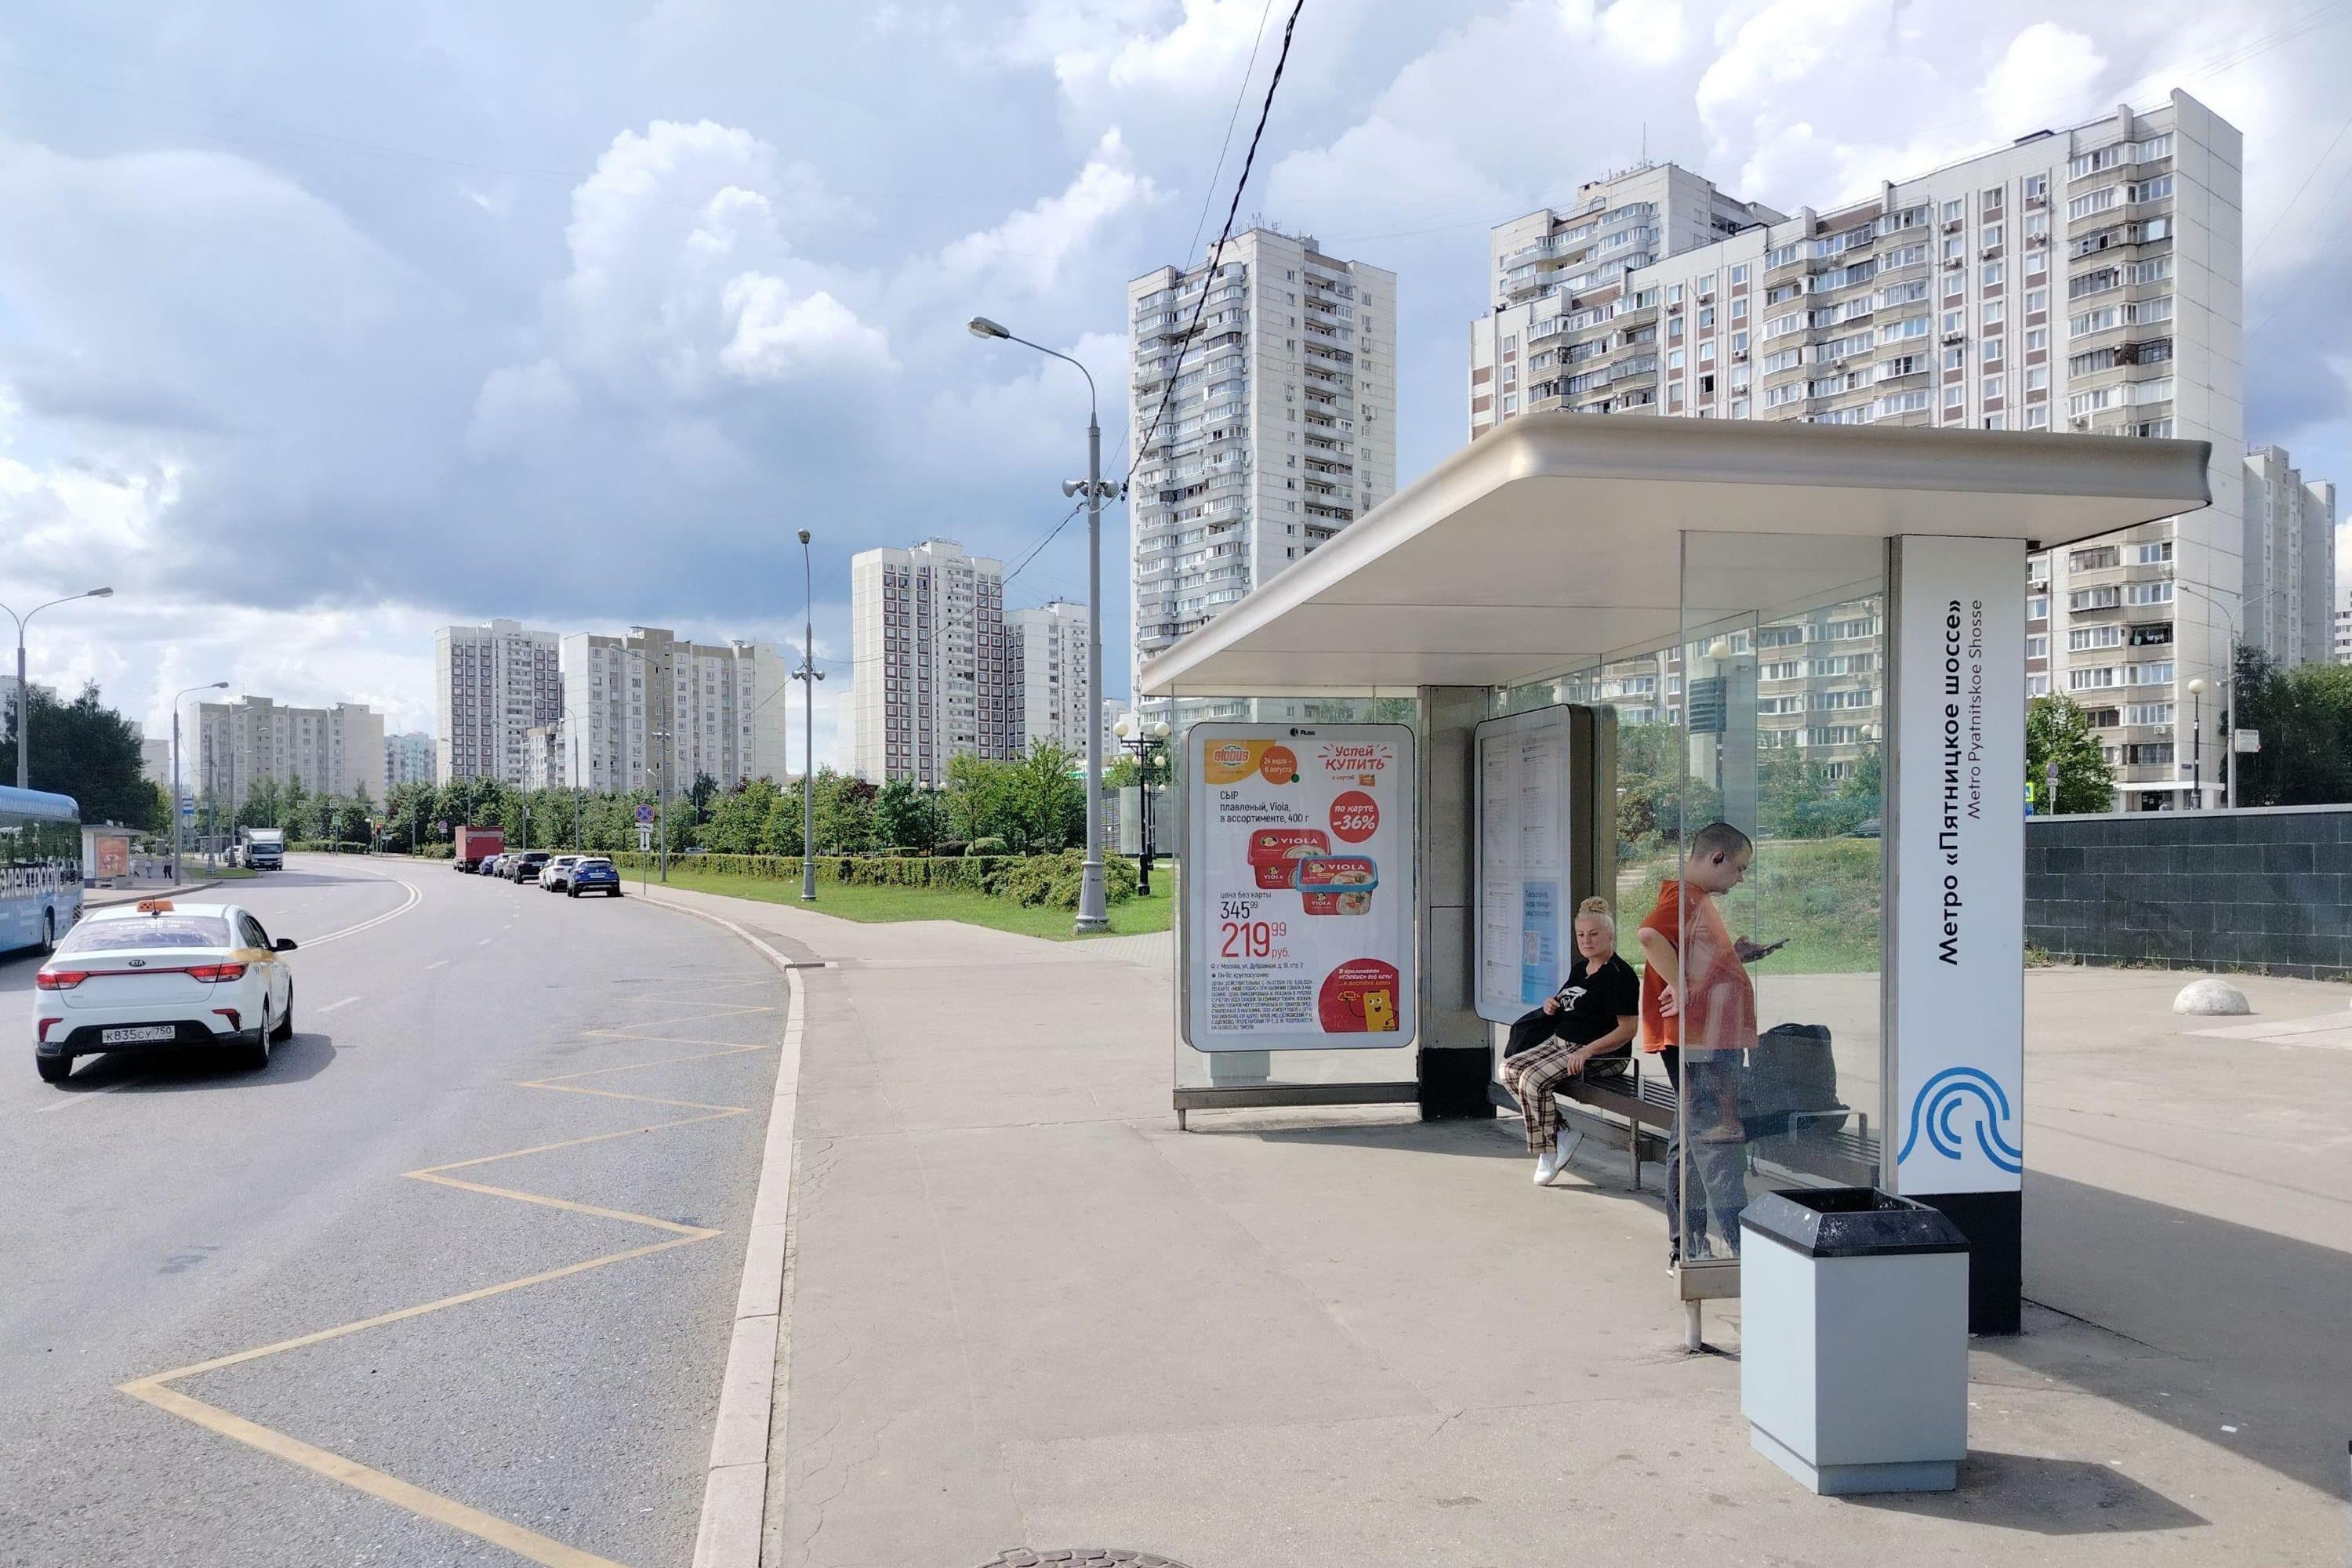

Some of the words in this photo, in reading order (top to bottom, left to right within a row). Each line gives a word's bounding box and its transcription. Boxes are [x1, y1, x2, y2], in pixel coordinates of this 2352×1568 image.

[1969, 600, 1982, 659] Shosse
[1945, 600, 1961, 695] шоссе»
[1968, 664, 1984, 761] Pyatnitskoe
[1325, 758, 1385, 771] КУПИТЬ
[1220, 790, 1239, 800] СЫР
[1939, 704, 1962, 865] «Пятницкое
[1968, 765, 1981, 819] Metro
[1220, 801, 1268, 812] плавленый,
[1226, 815, 1287, 824] ассортименте,
[1288, 814, 1304, 822] 400
[1348, 804, 1374, 814] карте
[0, 855, 64, 903] электробус
[1939, 875, 1962, 966] Метро
[1272, 947, 1290, 959] руб.
[154, 1026, 172, 1036] 750
